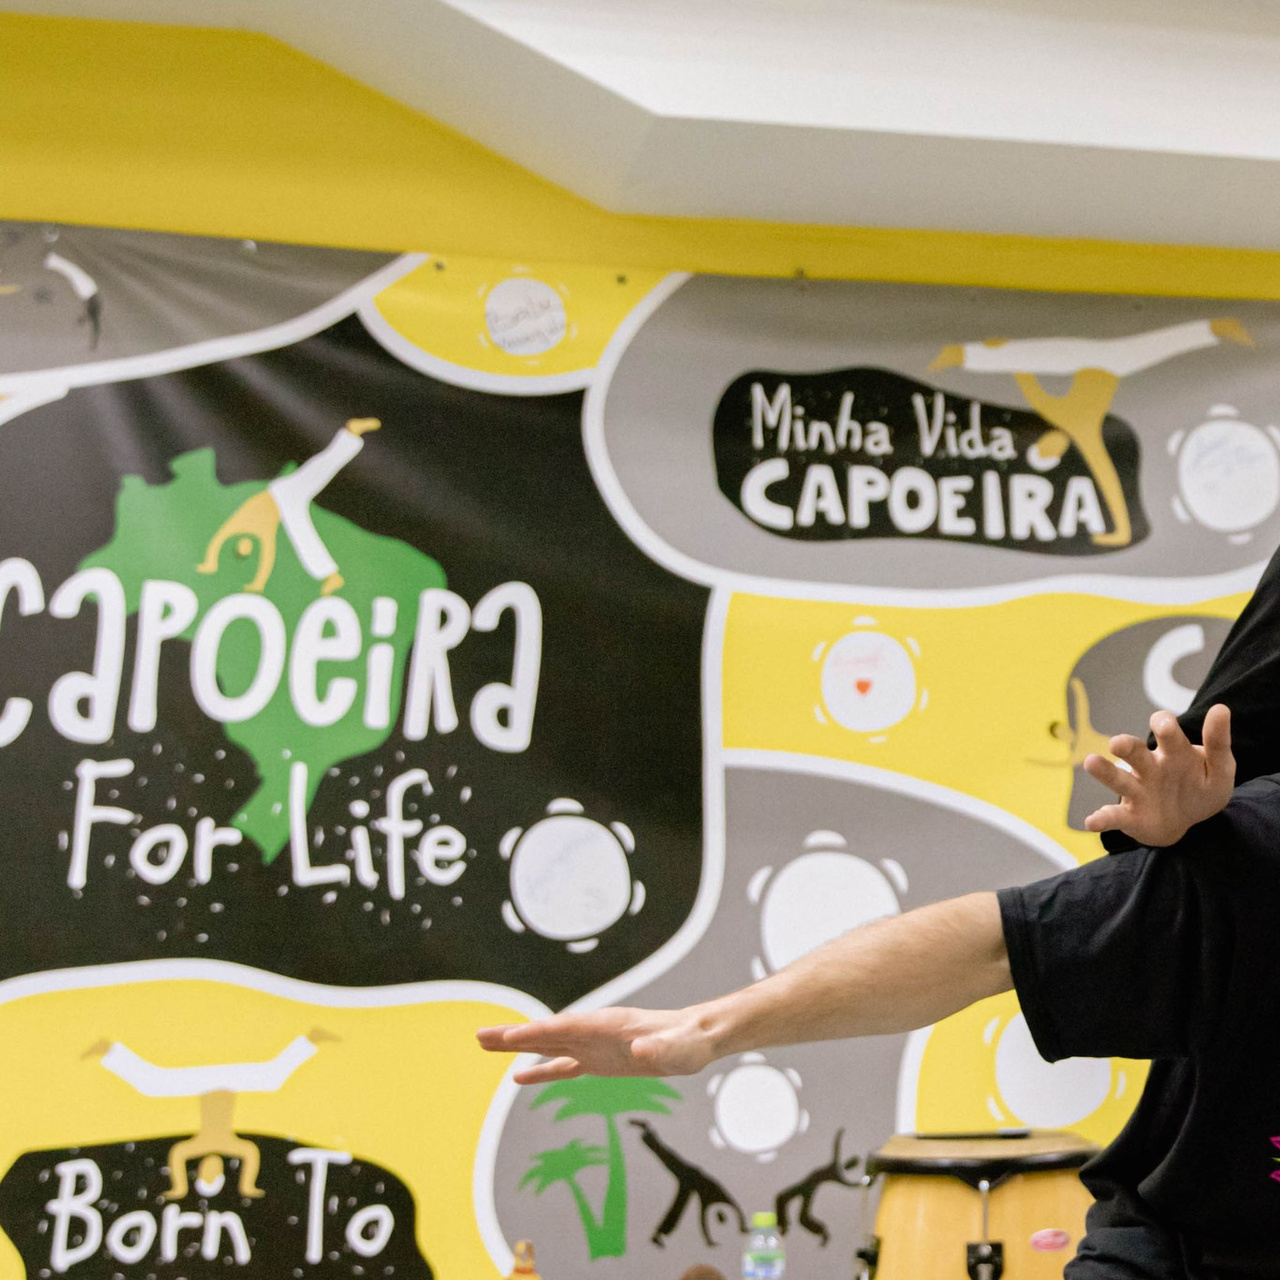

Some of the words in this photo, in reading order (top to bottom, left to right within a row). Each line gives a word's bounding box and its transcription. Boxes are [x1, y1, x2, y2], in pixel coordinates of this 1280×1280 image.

[750, 382, 892, 457] Minha
[913, 391, 1016, 458] Vida
[740, 457, 1106, 542] CAPOEIRA
[66, 758, 242, 890] For
[289, 760, 467, 900] Life
[46, 1158, 252, 1272] Born
[288, 1148, 394, 1264] To
